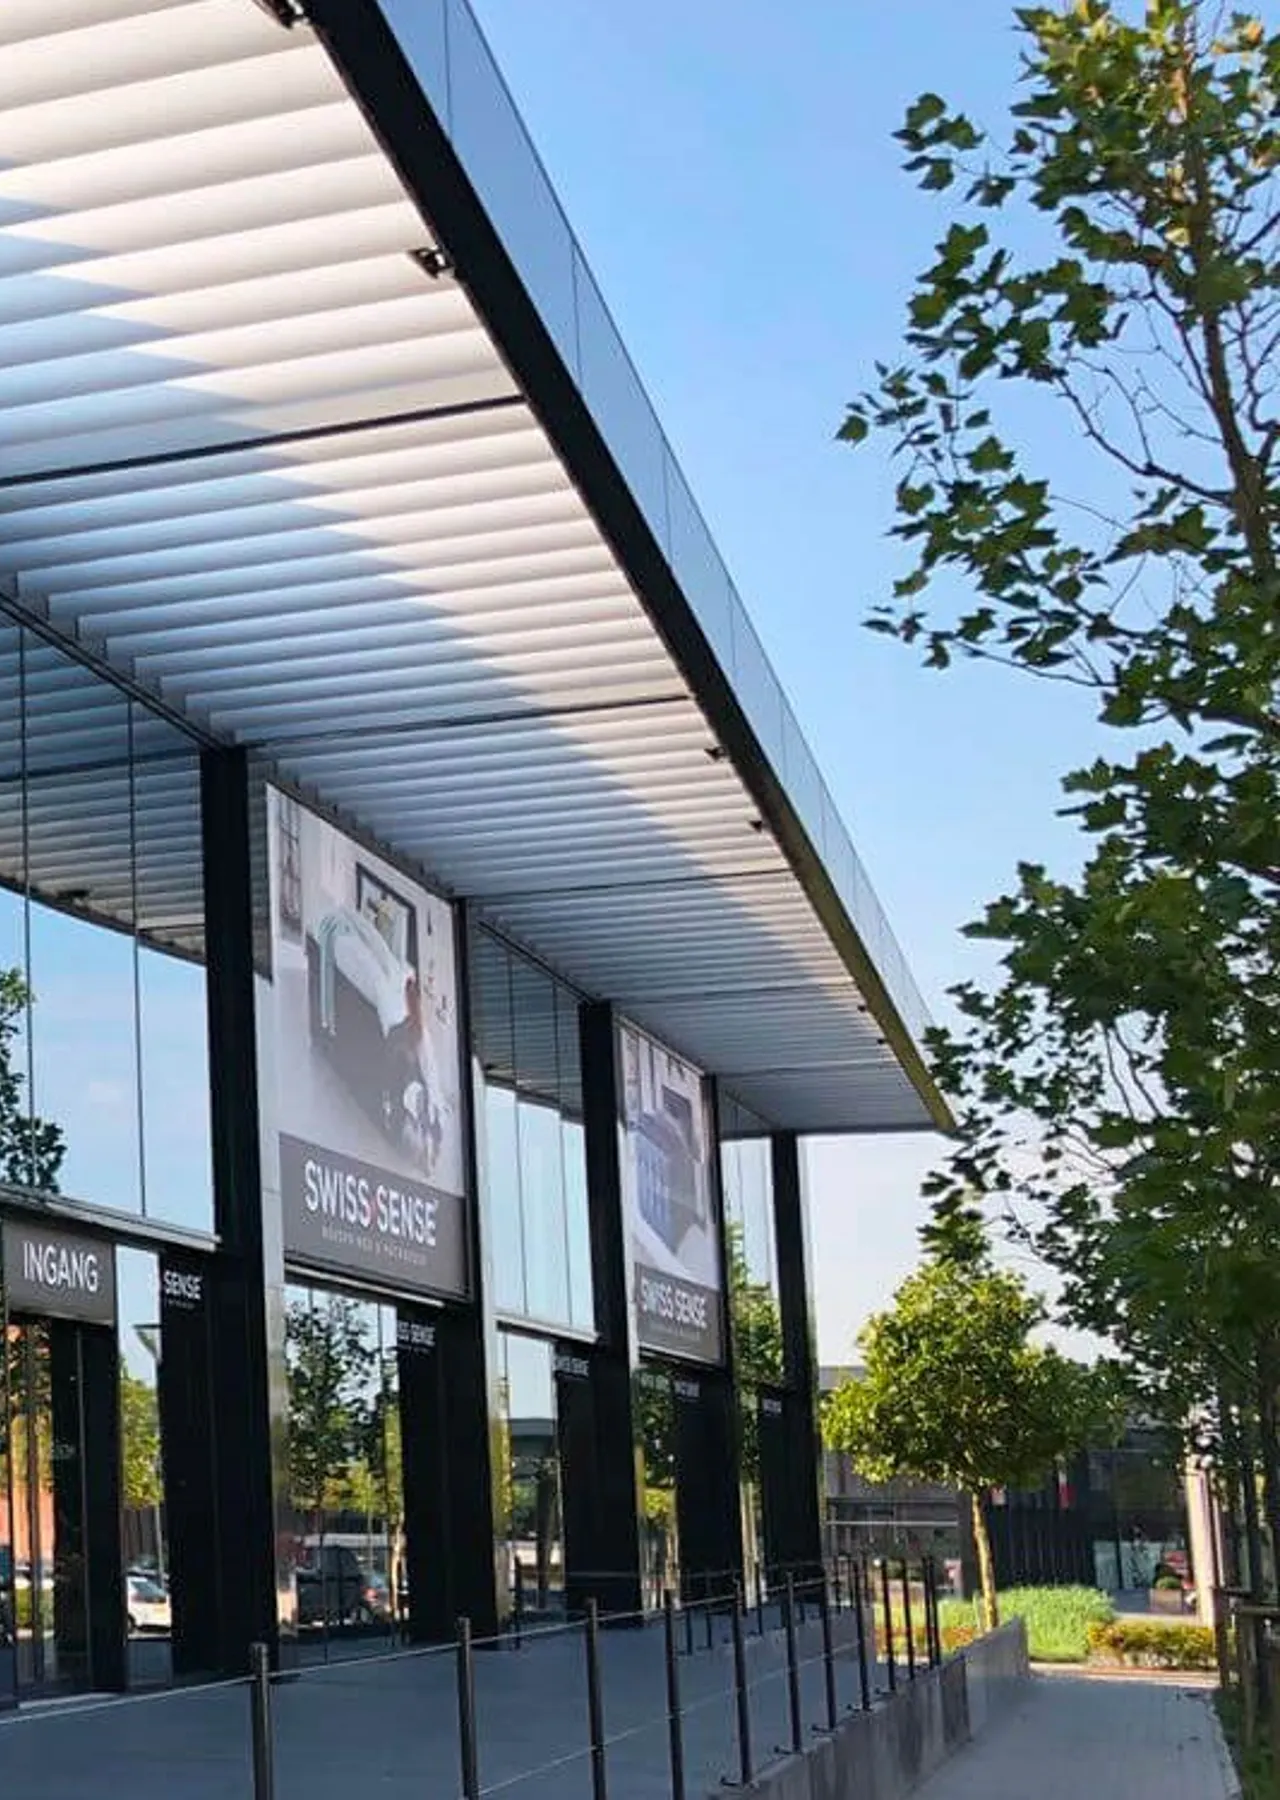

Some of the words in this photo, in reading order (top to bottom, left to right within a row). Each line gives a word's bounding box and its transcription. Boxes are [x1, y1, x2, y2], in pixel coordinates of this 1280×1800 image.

[304, 1159, 371, 1228] SWISS
[376, 1184, 437, 1246] SENSE
[23, 1241, 98, 1293] INGANG
